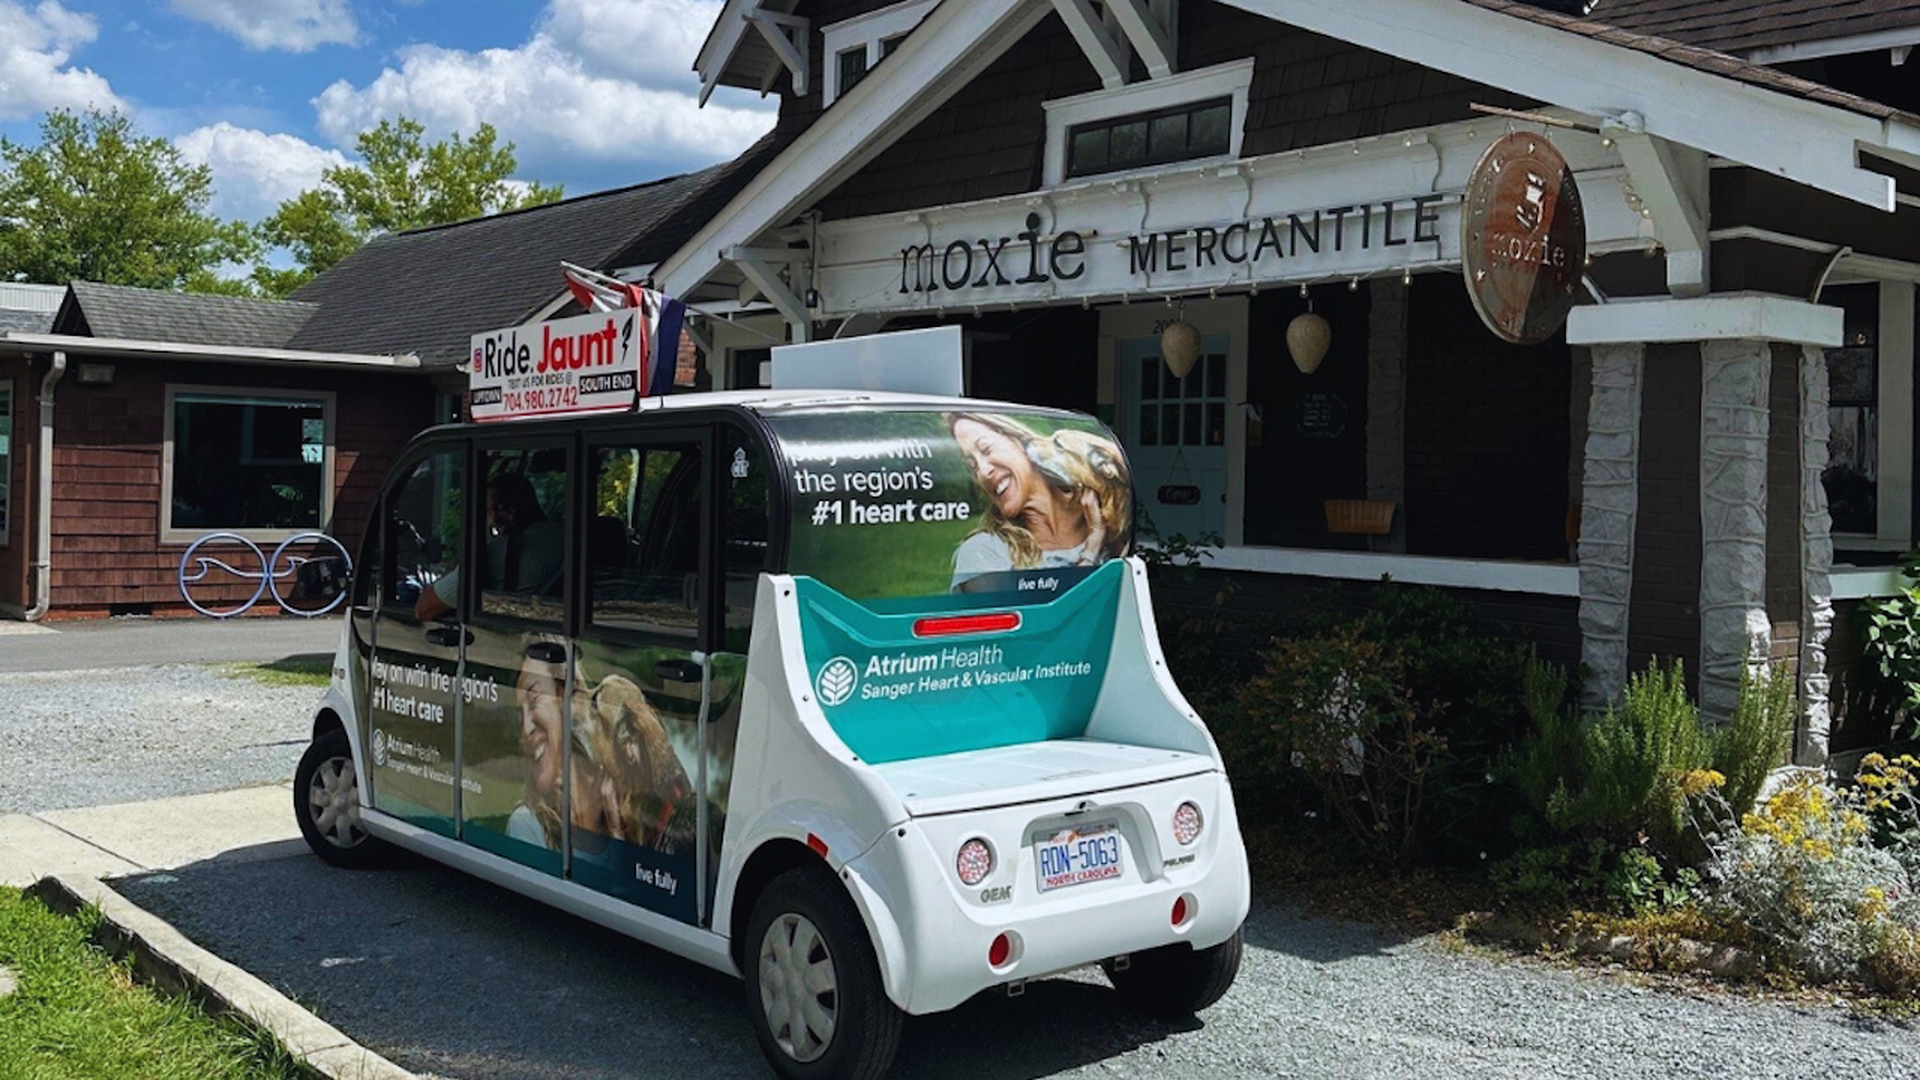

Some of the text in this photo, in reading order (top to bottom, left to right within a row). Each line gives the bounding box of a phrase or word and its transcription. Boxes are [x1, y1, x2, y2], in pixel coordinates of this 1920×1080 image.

[899, 212, 1085, 293] moxie
[1128, 194, 1443, 274] MERCANTILE
[485, 318, 617, 379] Ride. Jaunt
[531, 375, 545, 387] FOR
[545, 373, 564, 385] RIDES
[580, 374, 632, 392] SOUTH END
[503, 386, 578, 411] 704.980.2742
[794, 467, 933, 497] the region's
[812, 500, 970, 525] #1 heart care
[1018, 577, 1059, 591] live fully
[864, 644, 1003, 678] Atrium Health
[390, 665, 403, 682] on
[404, 663, 428, 687] with
[431, 666, 450, 692] the
[861, 660, 1091, 700] Sanger Heart & Vascular Institute
[373, 686, 444, 723] #1 heart care
[387, 734, 441, 763] Atrium Health
[1040, 836, 1118, 877] RDN-5063
[635, 863, 677, 895] live fully
[1046, 866, 1118, 887] NORTH CAROLINA
